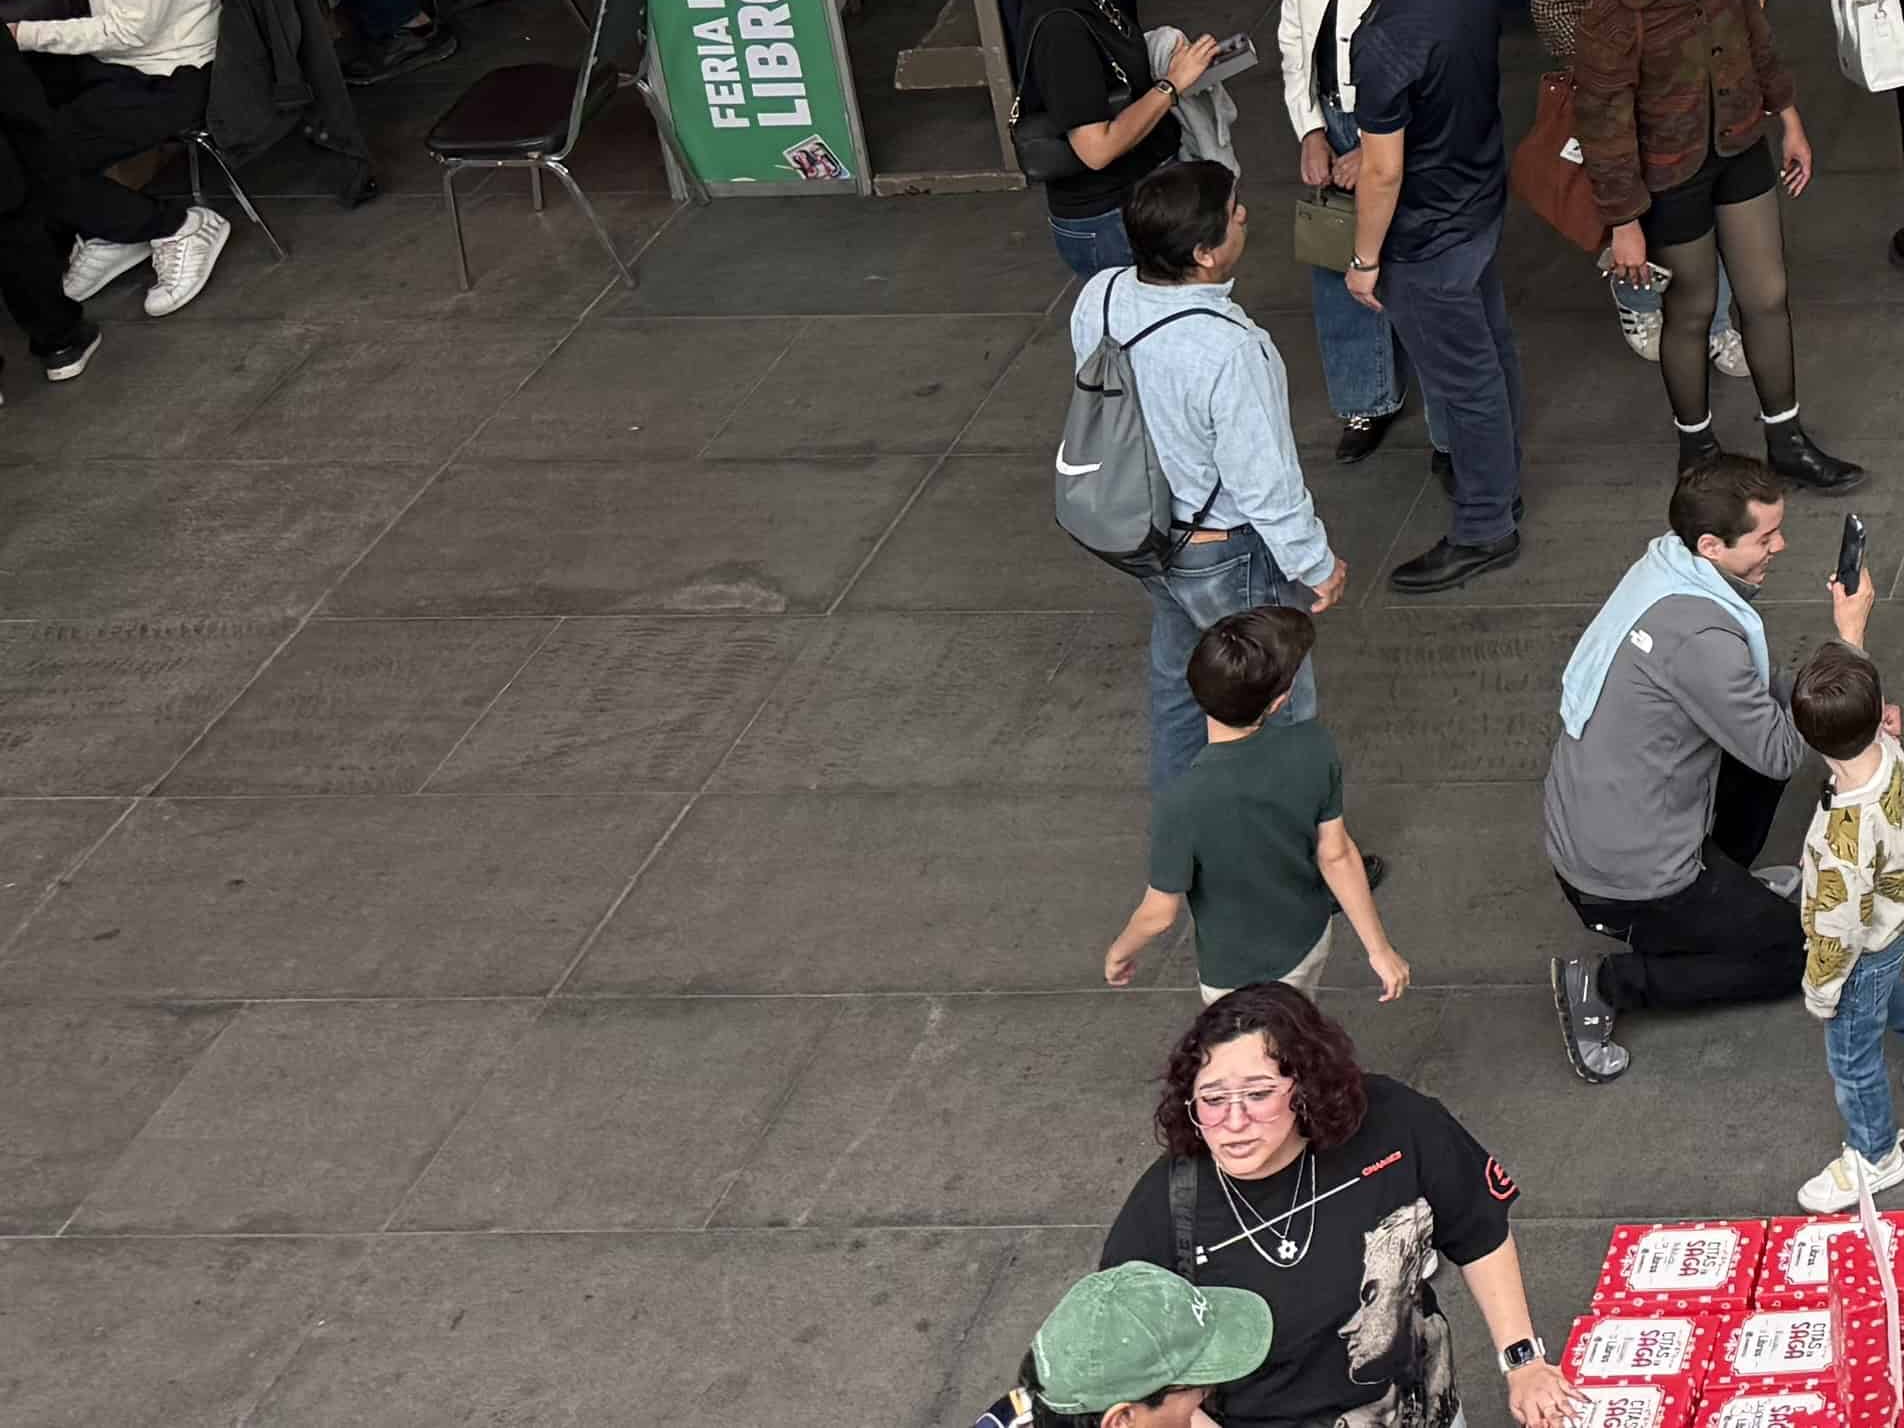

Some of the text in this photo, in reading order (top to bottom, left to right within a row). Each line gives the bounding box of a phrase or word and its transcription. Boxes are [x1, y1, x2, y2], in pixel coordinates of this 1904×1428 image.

[691, 17, 750, 130] FERIA
[1677, 1239, 1706, 1276] SAGA
[1702, 1240, 1721, 1268] CITAS
[1630, 1329, 1662, 1368] SAGA
[1659, 1330, 1677, 1359] CITAS
[1783, 1321, 1809, 1360] SAGA
[1808, 1322, 1827, 1350] CITAS
